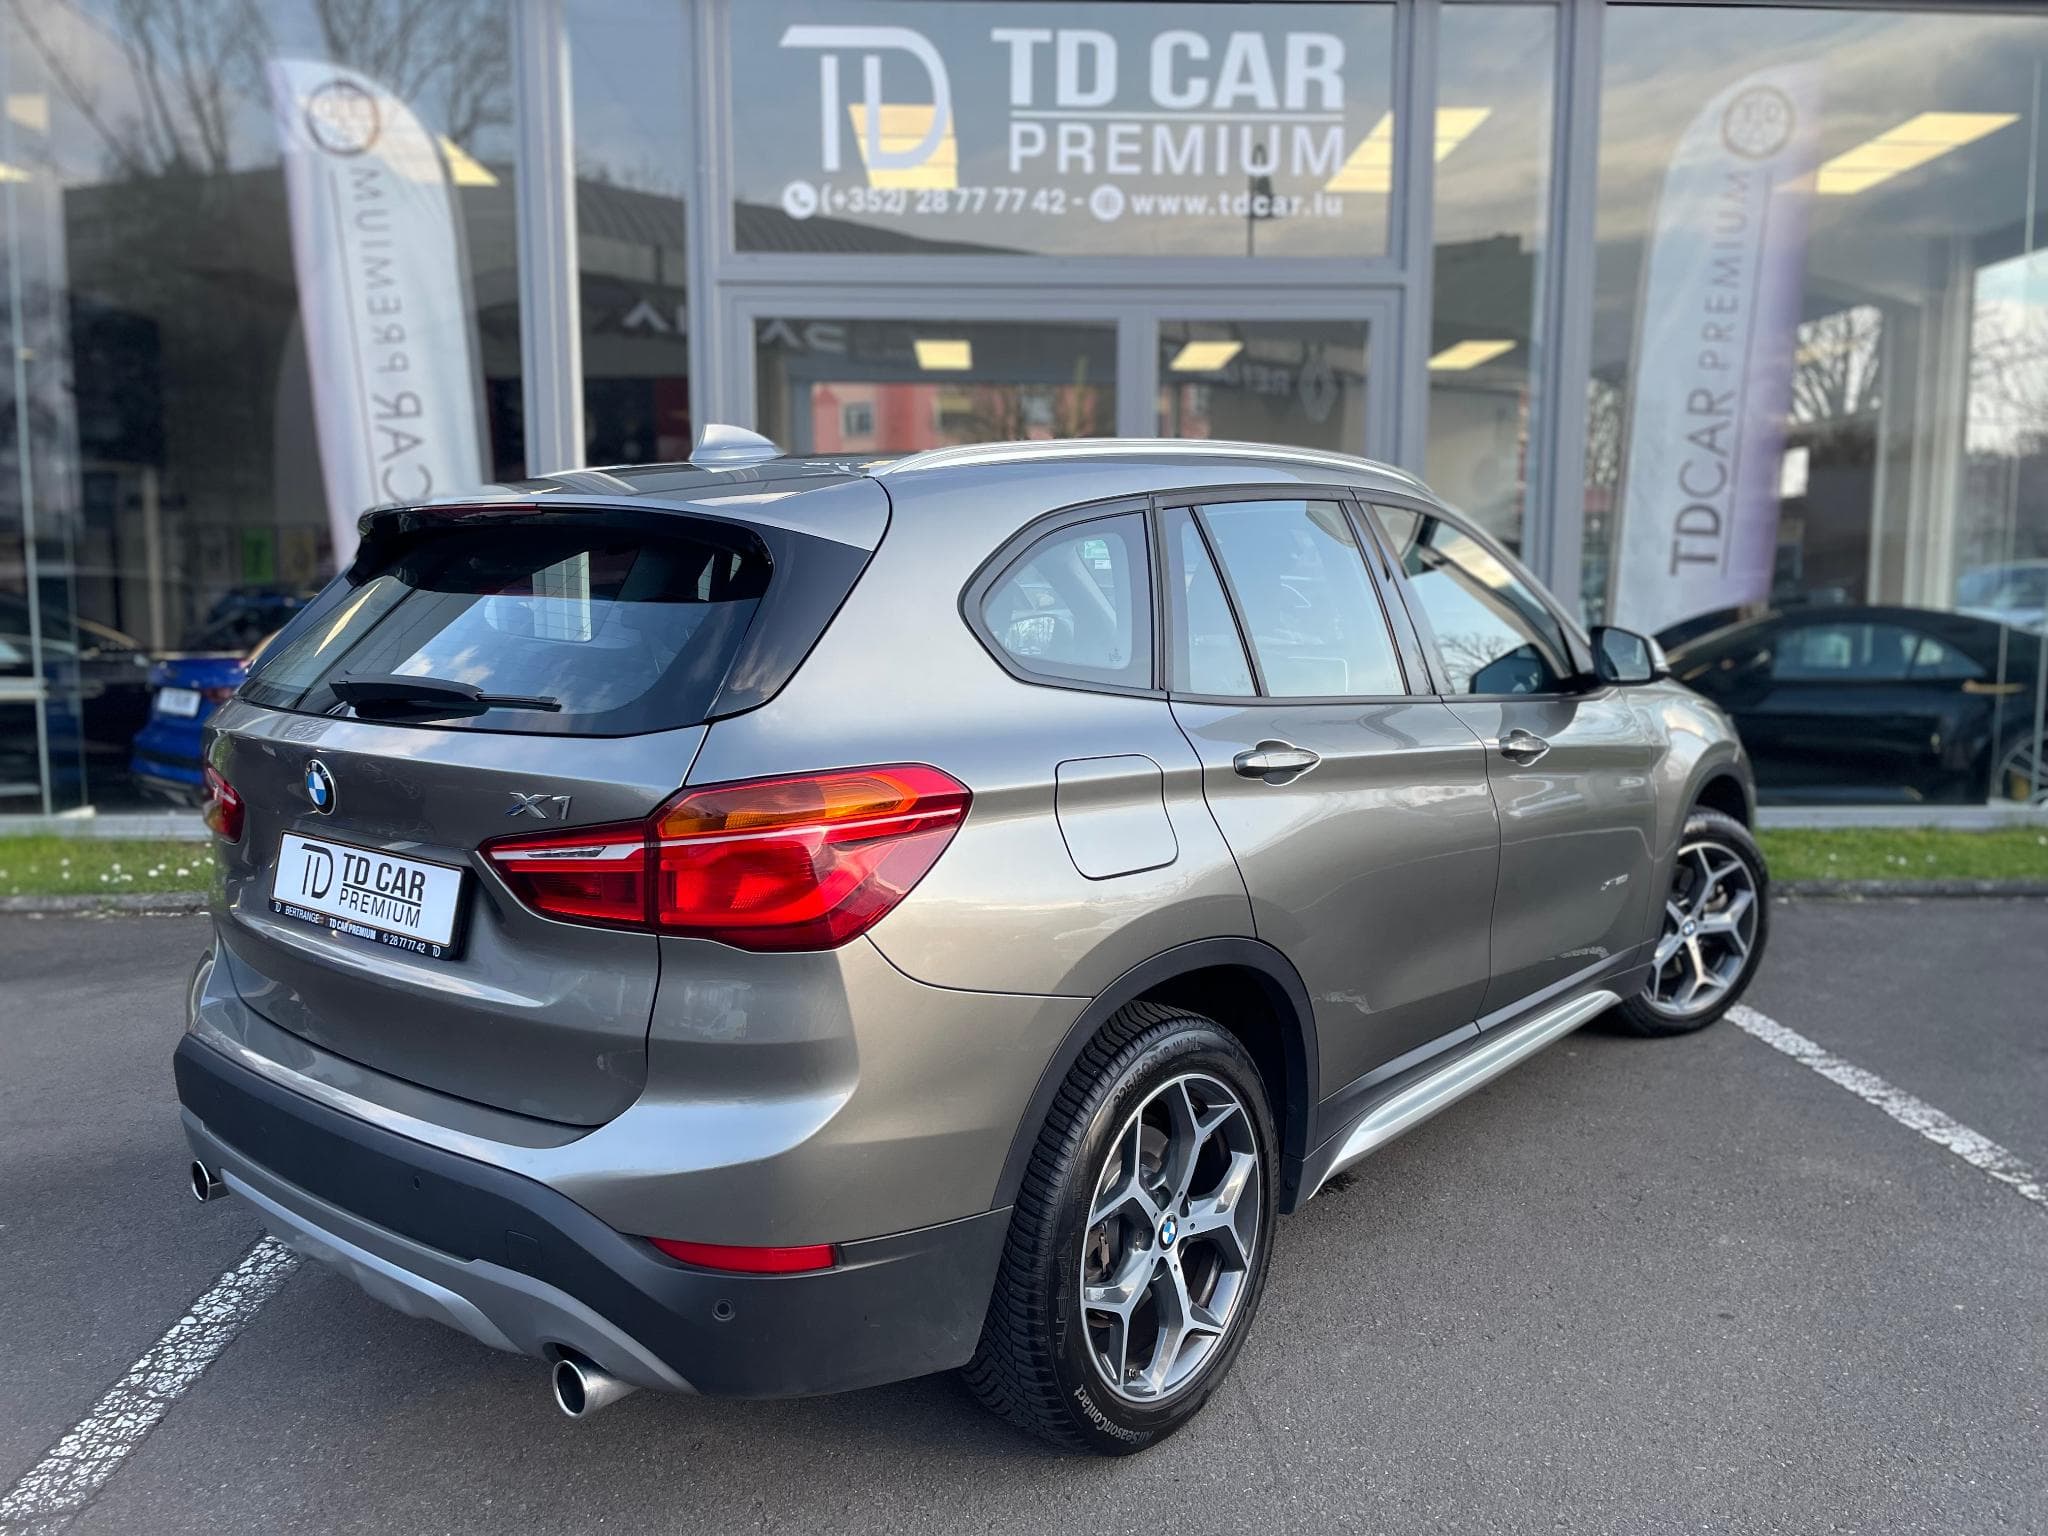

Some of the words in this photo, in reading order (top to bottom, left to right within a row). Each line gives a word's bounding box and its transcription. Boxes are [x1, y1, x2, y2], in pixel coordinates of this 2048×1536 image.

[991, 28, 1118, 108] TD
[1150, 31, 1347, 111] CAR
[779, 25, 953, 172] TD
[1009, 121, 1345, 176] PREMIUM
[820, 183, 907, 216] (+352)
[915, 187, 950, 215] 28
[955, 187, 987, 215] 77
[993, 187, 1028, 215] 77
[1031, 187, 1068, 216] 42
[1131, 191, 1344, 218] www.tdcar.lu
[1702, 168, 1753, 371] PREMIUM
[504, 792, 572, 820] X1
[342, 852, 371, 885] TD
[375, 862, 426, 902] CAR
[285, 905, 320, 924] BERTRANGE
[348, 923, 376, 940] PREMIUM
[389, 936, 399, 947] 28
[415, 942, 426, 954] 42
[338, 888, 422, 928] PREMIUM
